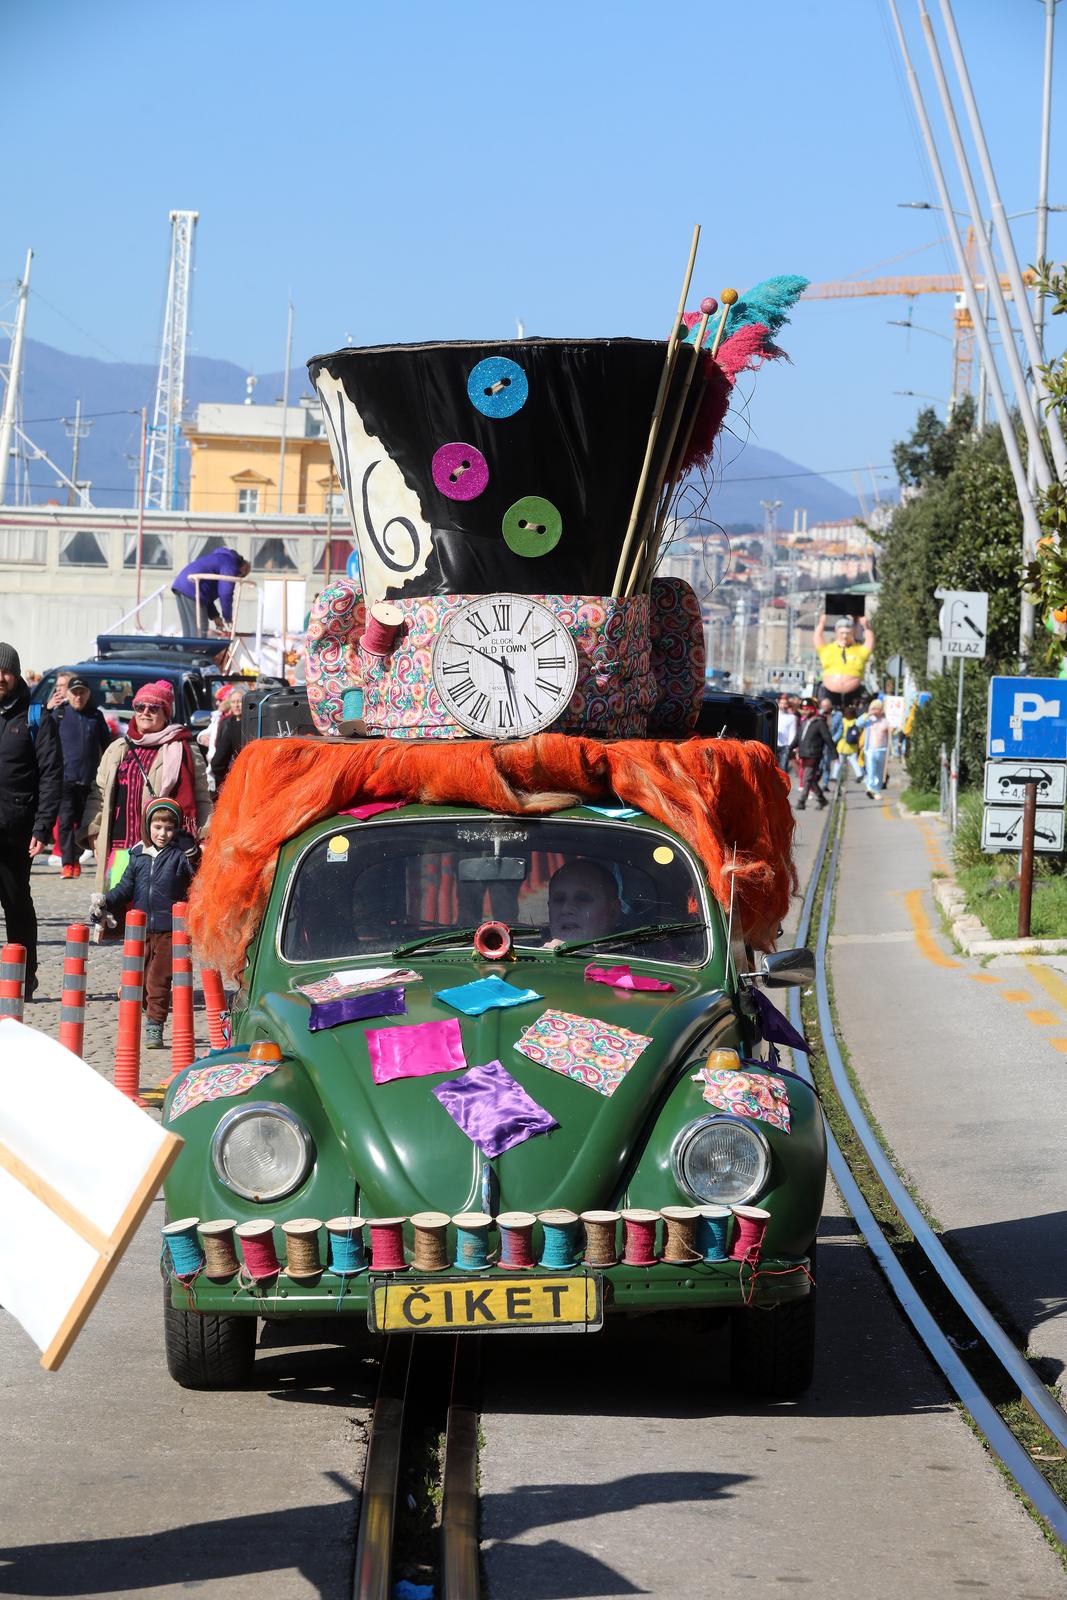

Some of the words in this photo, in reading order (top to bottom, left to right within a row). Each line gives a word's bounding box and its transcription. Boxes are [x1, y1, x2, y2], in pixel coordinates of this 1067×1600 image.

[465, 611, 491, 641] XI
[492, 604, 510, 631] XII
[518, 610, 533, 635] I
[479, 646, 497, 654] OLD
[500, 644, 527, 653] TOWN
[531, 629, 557, 650] II
[948, 642, 980, 653] IZLAZ
[443, 660, 469, 675] IX
[538, 656, 566, 669] III
[447, 676, 478, 707] VIII
[535, 678, 562, 701] IV
[468, 692, 491, 723] VII
[498, 700, 514, 727] VI
[523, 694, 543, 719] V
[1013, 692, 1046, 741] P
[402, 1285, 569, 1325] ČIKET
